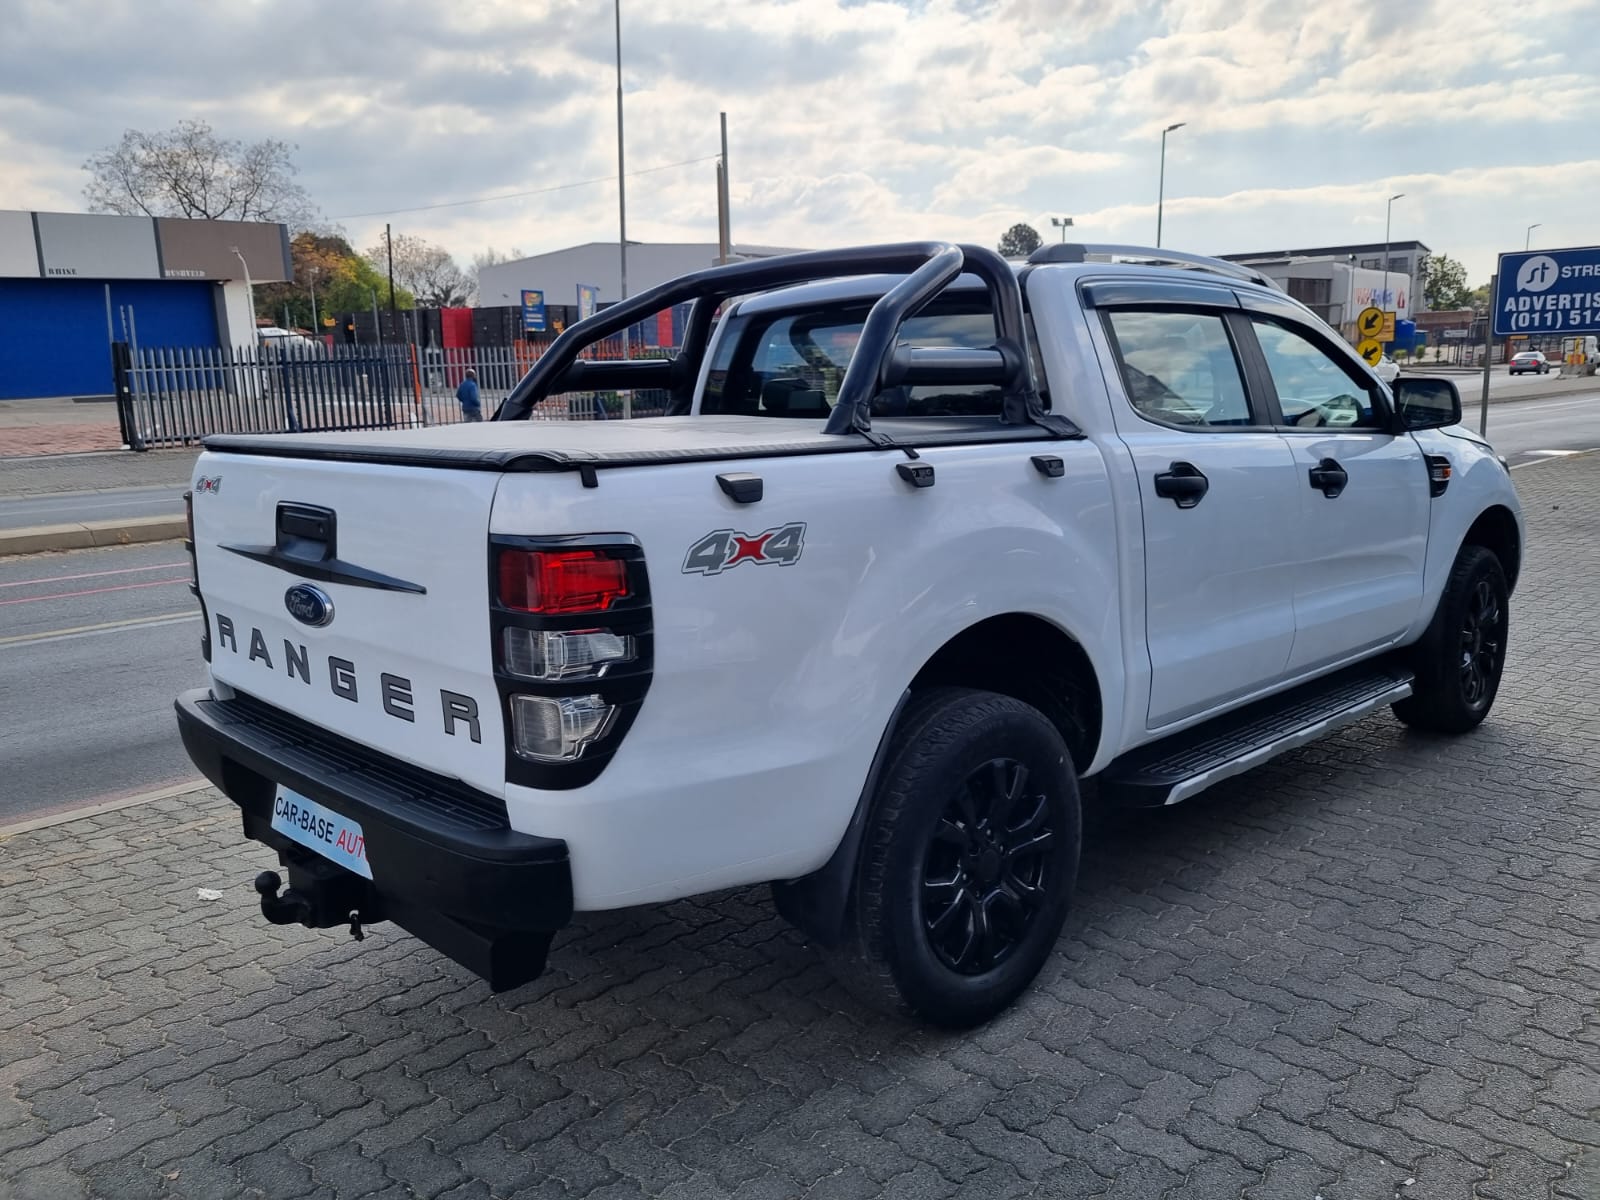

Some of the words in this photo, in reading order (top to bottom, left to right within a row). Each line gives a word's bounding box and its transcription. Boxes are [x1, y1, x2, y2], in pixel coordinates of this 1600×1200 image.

[1510, 311, 1562, 331] (011)
[289, 590, 315, 618] Ford
[216, 613, 481, 744] RANGER
[275, 797, 334, 844] CAR-BASE
[336, 829, 368, 862] AUT
